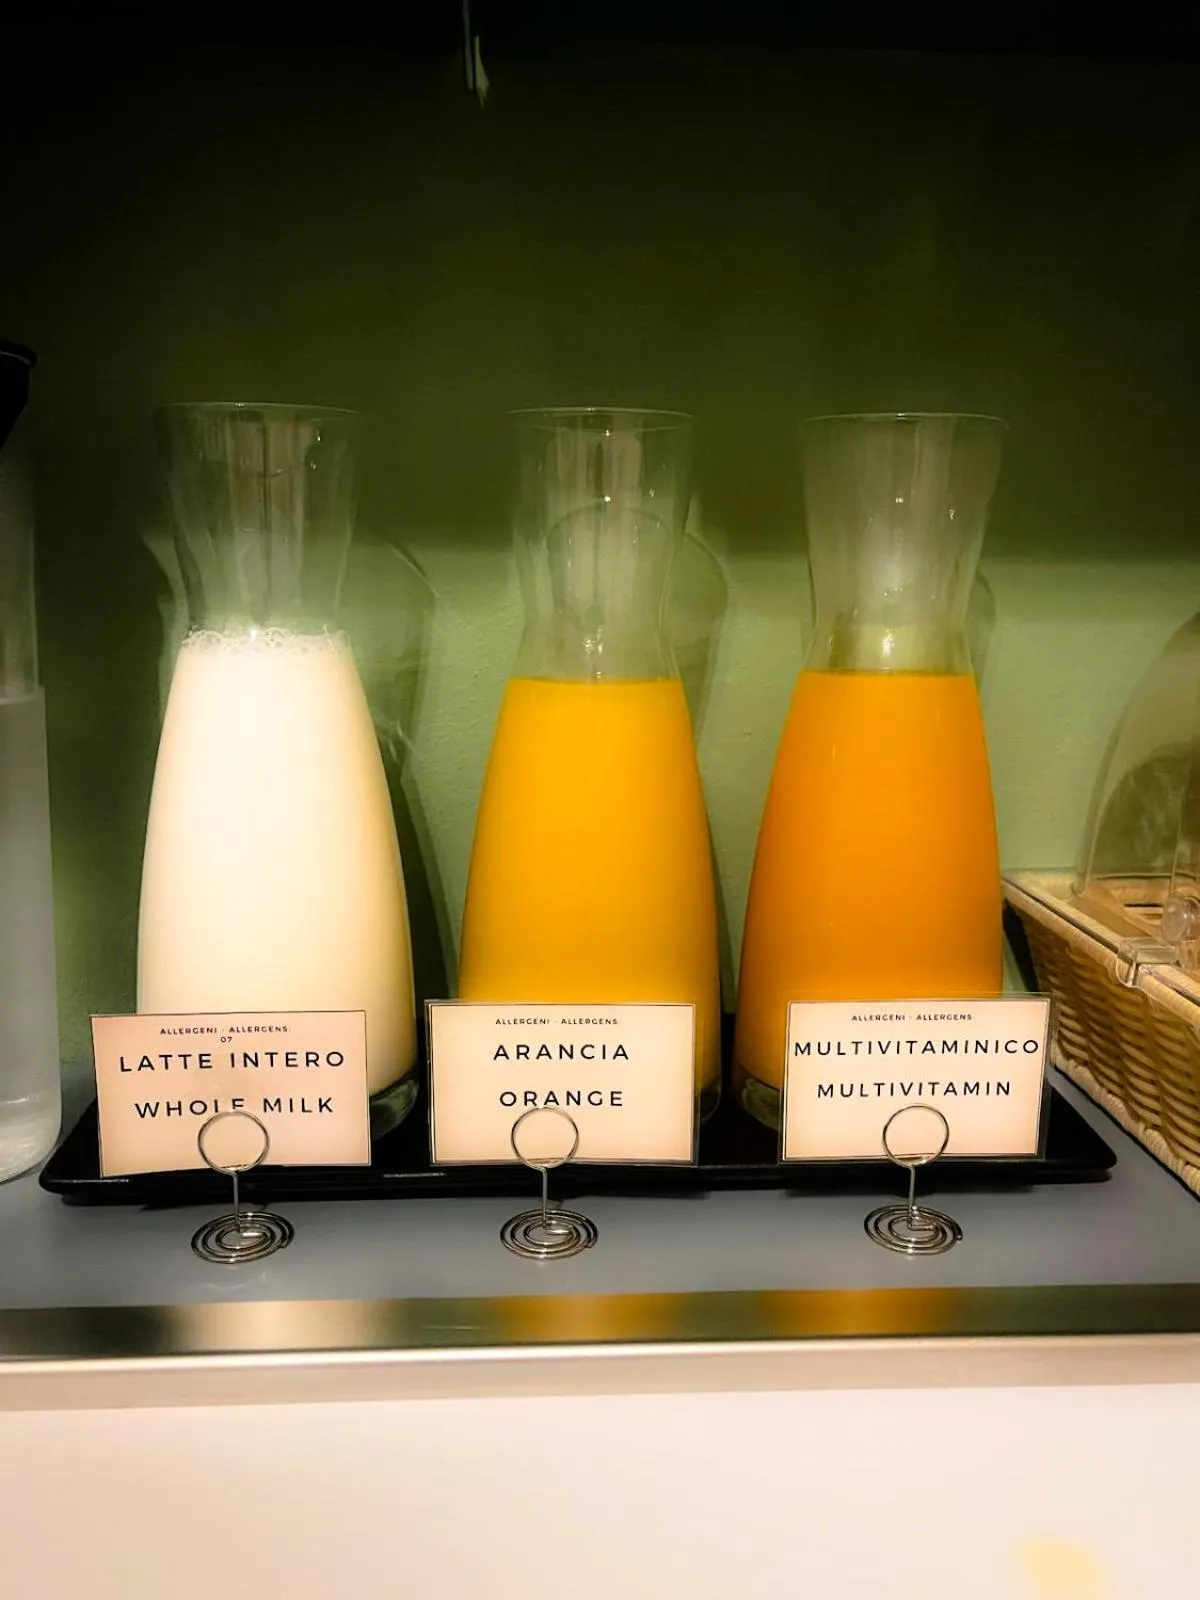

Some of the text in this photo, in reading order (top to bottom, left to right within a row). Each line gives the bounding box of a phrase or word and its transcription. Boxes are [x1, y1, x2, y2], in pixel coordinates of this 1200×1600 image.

[495, 1017, 550, 1025] ALLERGENI
[851, 1013, 905, 1021] ALLERGENI
[160, 1027, 217, 1035] ALLERGENI
[220, 1036, 233, 1044] 07
[795, 1039, 1039, 1056] MULTIVITAMINICO
[494, 1044, 629, 1060] ARANCIA
[120, 1051, 345, 1072] LATTE INTERO
[818, 1081, 1010, 1098] MULTIVITAMIN
[264, 1097, 333, 1113] MILK
[500, 1090, 623, 1107] ORANGE
